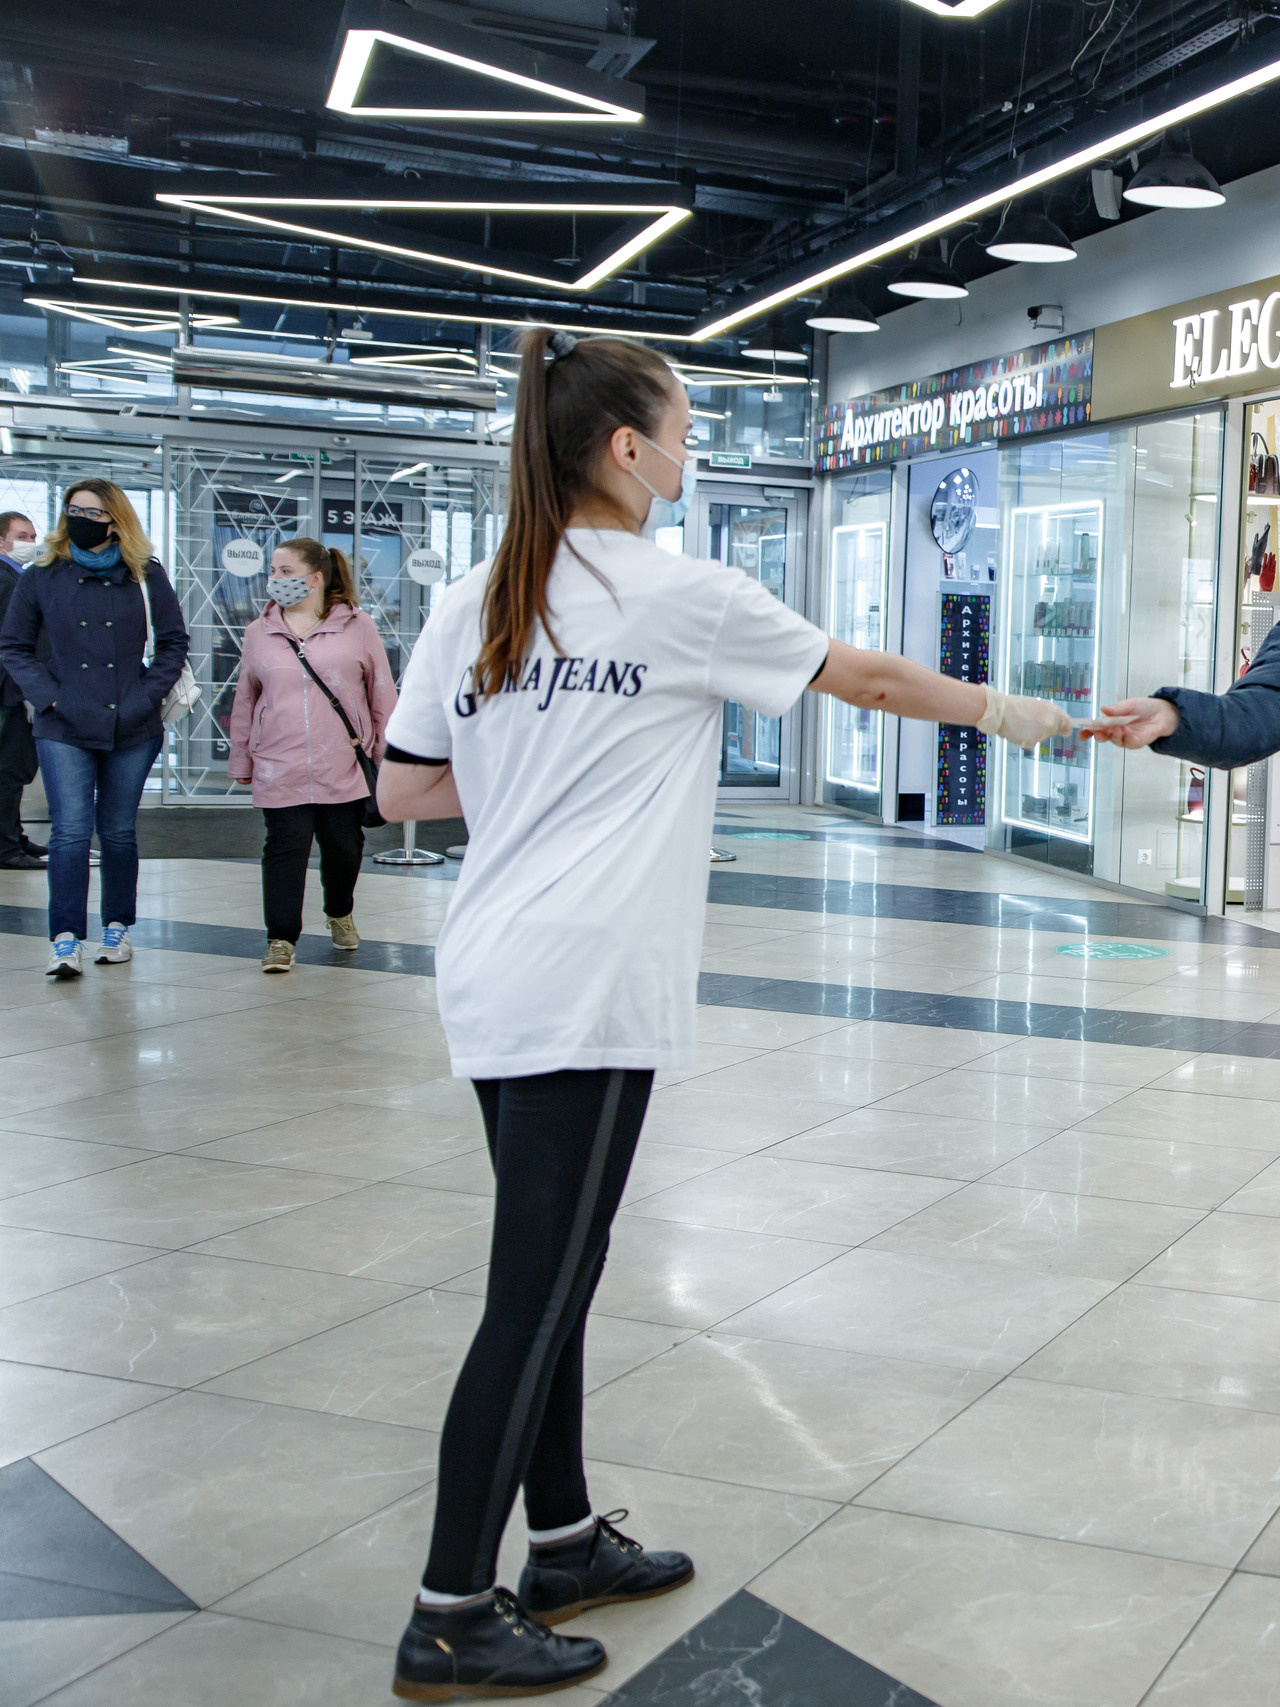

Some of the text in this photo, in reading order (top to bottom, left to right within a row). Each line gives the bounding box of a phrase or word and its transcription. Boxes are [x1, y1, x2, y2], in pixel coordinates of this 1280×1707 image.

[840, 372, 1044, 461] Архитектор красоты
[327, 509, 398, 526] 5 ЭАЖ
[227, 549, 259, 560] ВЫХОД
[412, 559, 441, 569] ВЫХОД
[538, 658, 647, 711] JEANS
[957, 605, 973, 806] Архитек красоты
